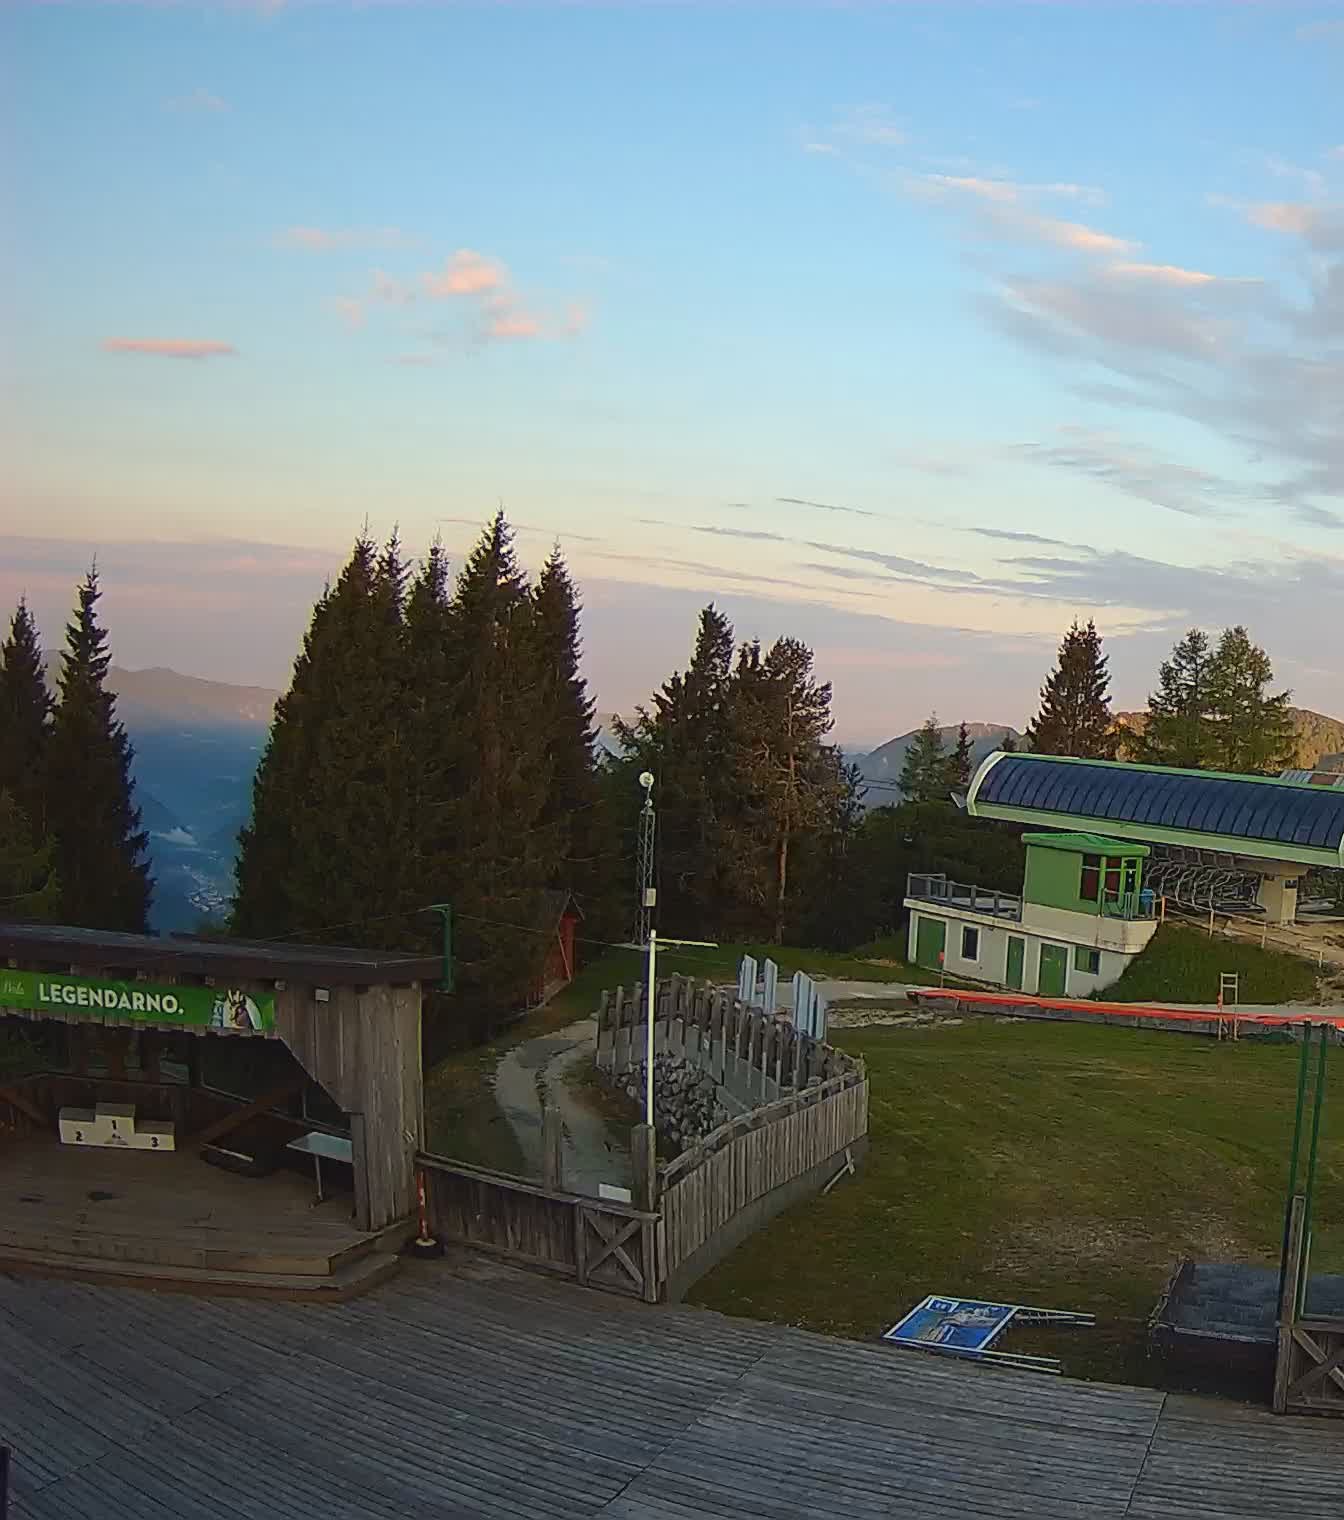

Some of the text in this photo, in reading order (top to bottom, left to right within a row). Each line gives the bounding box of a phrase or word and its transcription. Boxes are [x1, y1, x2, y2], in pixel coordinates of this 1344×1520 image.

[39, 983, 184, 1015] LEGENDARNO.
[112, 1120, 117, 1130] 1
[76, 1131, 83, 1142] 2
[151, 1136, 159, 1148] 3
